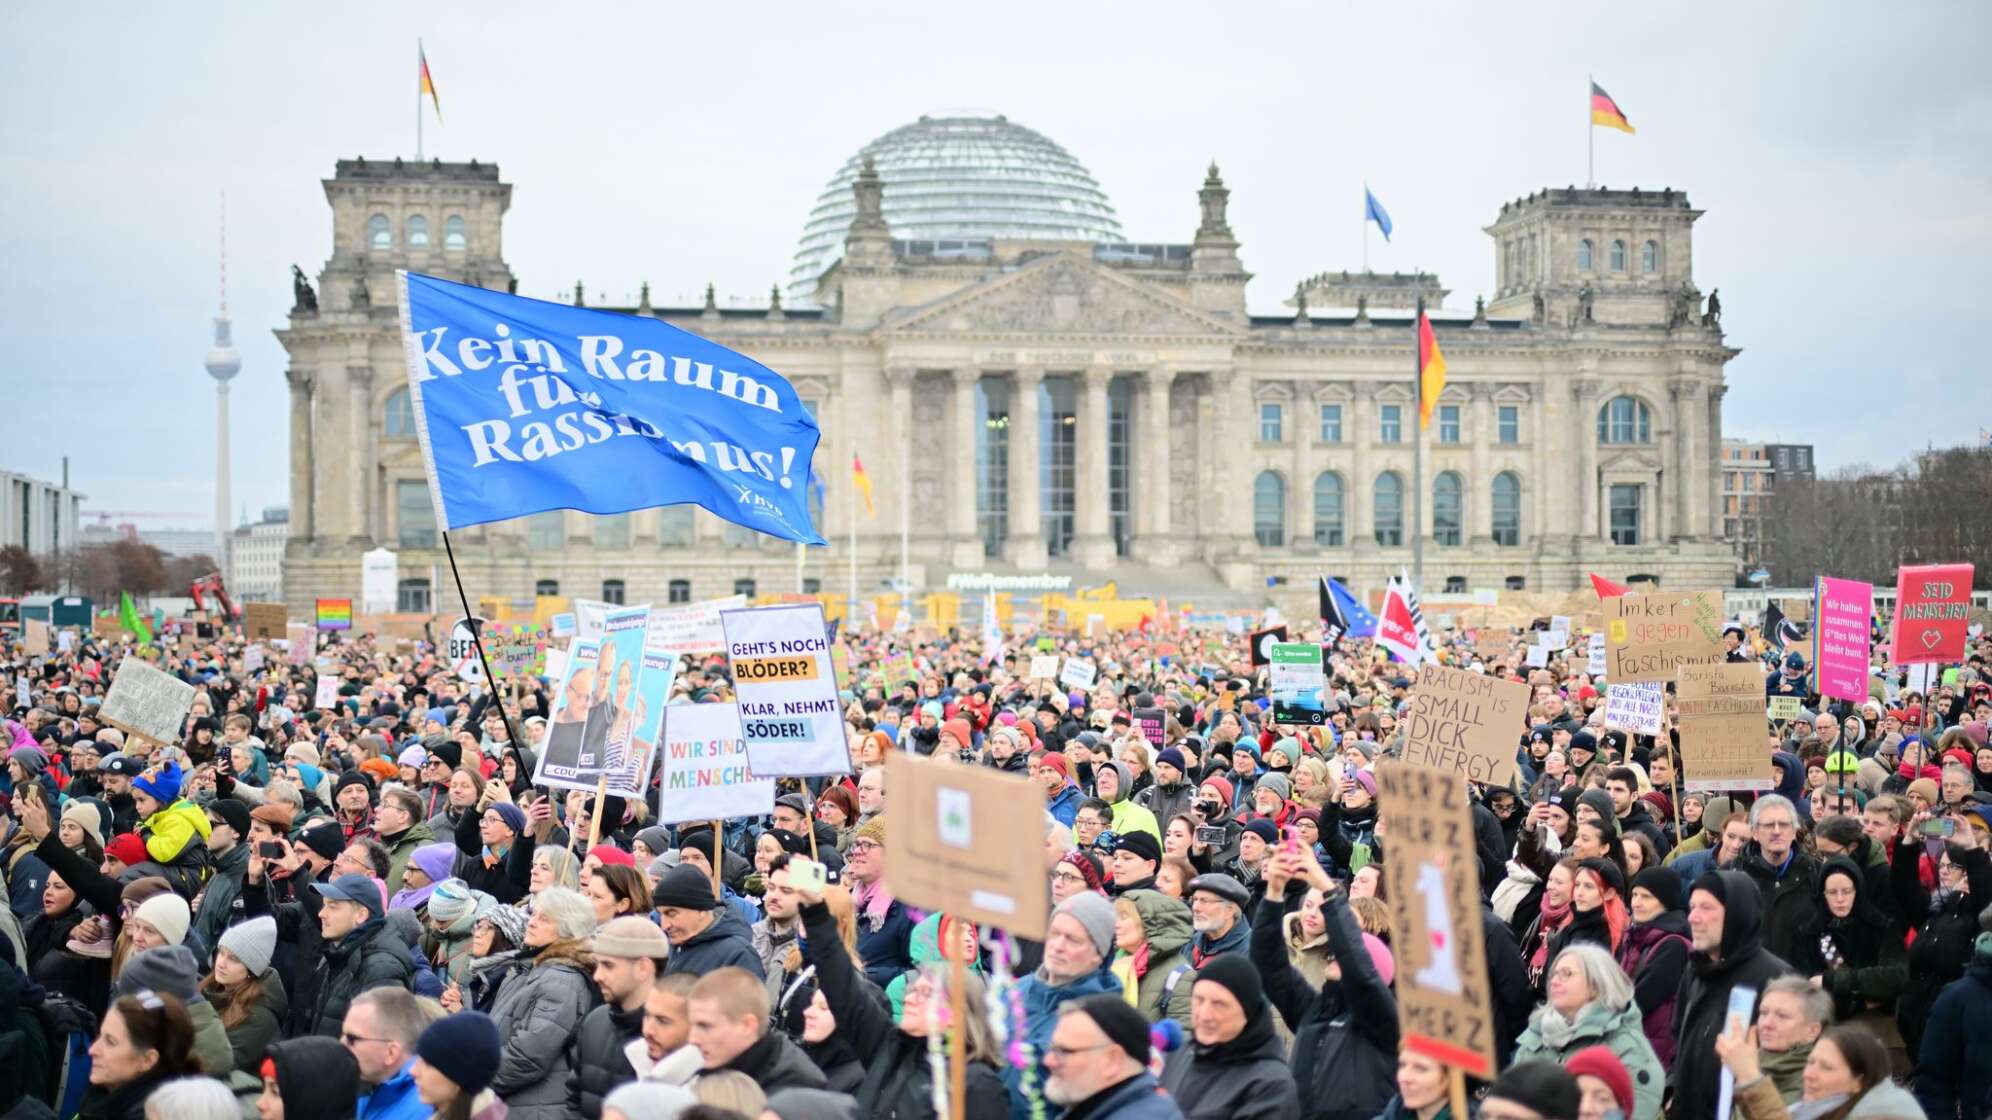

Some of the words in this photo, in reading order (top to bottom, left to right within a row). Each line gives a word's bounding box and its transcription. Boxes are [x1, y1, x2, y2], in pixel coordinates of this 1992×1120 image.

[413, 323, 568, 382] Kein
[577, 335, 783, 414] Raum
[498, 364, 602, 419] für
[1922, 582, 1953, 598] SEID
[1619, 596, 1678, 617] Imker
[1825, 599, 1839, 610] Wir
[1840, 600, 1863, 614] halten
[1903, 602, 1969, 621] MENSCHEN
[1635, 623, 1689, 643] gegen
[1825, 616, 1866, 630] zusammen.
[732, 641, 777, 655] GEHT'S
[781, 638, 826, 653] NOCH
[1848, 631, 1865, 645] Welt
[736, 658, 808, 679] BLÖDER?
[1424, 666, 1494, 697] RACISM
[1492, 699, 1511, 713] IS
[742, 703, 780, 717] KLAR,
[784, 699, 836, 714] NEHMT
[1416, 694, 1484, 726] SMALL
[746, 719, 806, 738] SÖDER!
[1410, 715, 1469, 749] DICK
[670, 741, 704, 759] WIR
[708, 738, 746, 757] SIND
[1406, 740, 1500, 782] ENERGY
